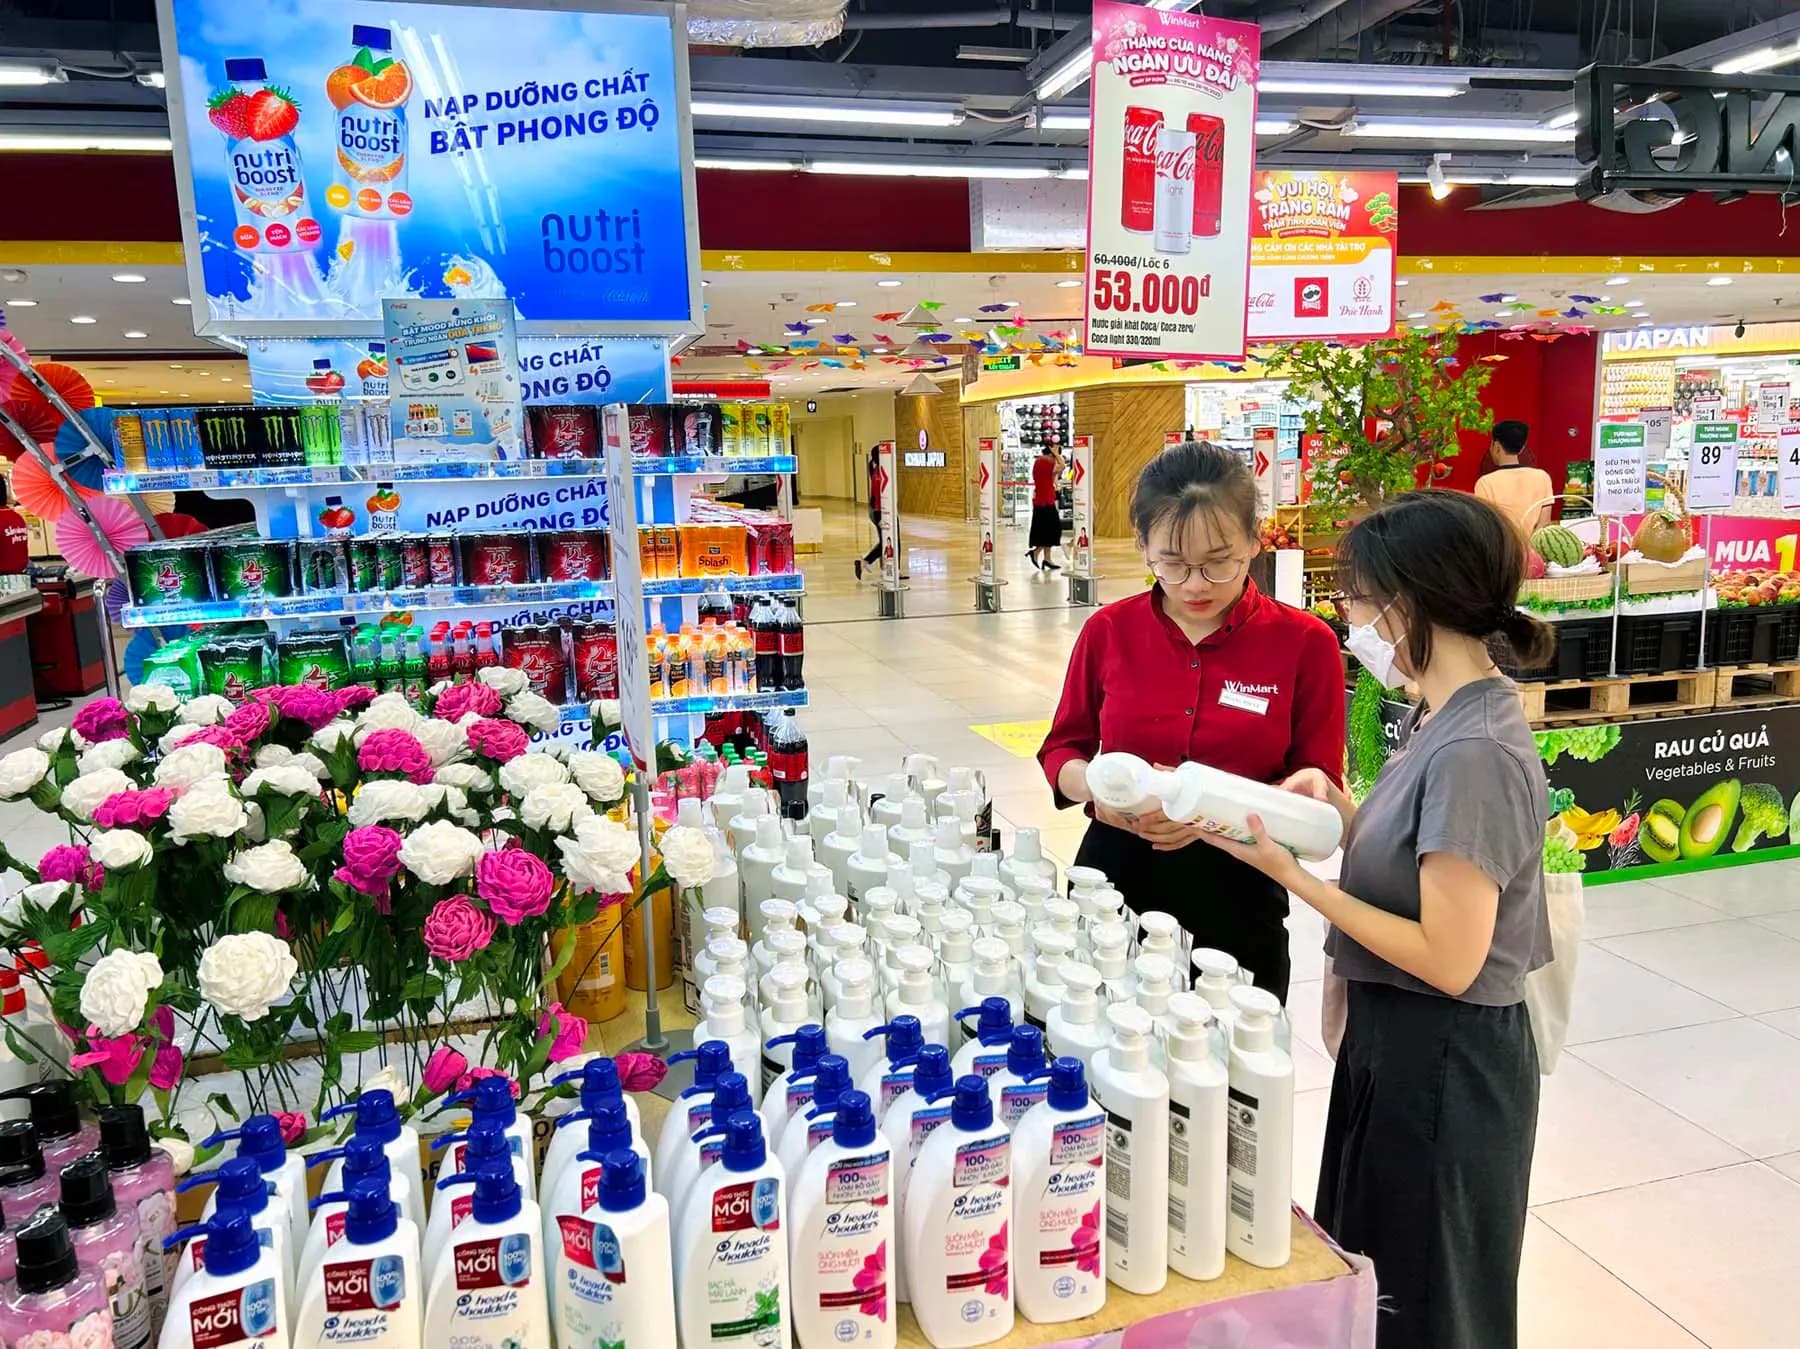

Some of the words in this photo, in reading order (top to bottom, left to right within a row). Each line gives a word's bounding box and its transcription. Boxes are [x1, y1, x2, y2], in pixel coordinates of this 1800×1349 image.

[1158, 12, 1200, 29] WinMart
[1122, 34, 1166, 50] THÁNG
[1198, 44, 1232, 66] NÀNG
[1112, 50, 1170, 75] NGÀN
[1205, 66, 1238, 92] ĐÃI
[424, 94, 478, 120] NẠP
[486, 80, 578, 112] DƯỠNG
[584, 68, 650, 98] CHẤT
[342, 116, 398, 136] nutri
[431, 121, 488, 156] BẬT
[498, 111, 608, 145] PHONG
[616, 98, 660, 132] ĐỘ
[342, 132, 400, 153] boost
[234, 148, 292, 169] nutri
[236, 166, 297, 186] boost
[1277, 180, 1303, 197] VUI
[1308, 178, 1334, 200] HỘI
[1259, 198, 1312, 220] TRĂNG
[541, 208, 640, 242] nutri
[543, 239, 645, 275] boost
[1163, 258, 1170, 270] 6
[420, 322, 446, 333] MOOD
[1092, 318, 1109, 329] Nước
[1110, 318, 1122, 330] giải
[1124, 319, 1139, 330] khát
[1161, 322, 1176, 332] Coca
[1092, 333, 1108, 344] Coca
[1110, 334, 1124, 344] light
[1620, 327, 1708, 350] JAPAN
[550, 341, 604, 368] CHẤT
[576, 366, 611, 392] ĐỘ
[363, 388, 389, 396] boost
[1701, 446, 1720, 464] 89
[427, 508, 470, 530] NẠP
[476, 492, 550, 518] DƯỠNG
[556, 478, 608, 503] CHẤT
[372, 522, 396, 530] boost
[698, 555, 728, 568] Splash
[1714, 540, 1771, 562] MUA
[1776, 534, 1798, 573] 1
[1224, 680, 1278, 694] WinMart
[1654, 738, 1695, 758] RAU
[1699, 729, 1724, 754] CỦ
[1730, 724, 1770, 750] QUẢ
[1645, 761, 1721, 781] Vegetables
[1724, 758, 1734, 772] &
[1738, 754, 1776, 770] Fruits
[1049, 1180, 1096, 1194] shoulders
[714, 1198, 750, 1217] MỚI
[844, 1210, 880, 1223] head&
[955, 1201, 1002, 1216] shoulders
[828, 1220, 880, 1233] shoulders
[564, 1229, 591, 1251] MỚI
[734, 1234, 771, 1251] head&
[457, 1254, 496, 1274] MỚI
[718, 1248, 770, 1263] shoulders
[327, 1275, 368, 1296] MỚI
[569, 1282, 612, 1301] shoulders
[579, 1274, 612, 1292] head&
[476, 1290, 518, 1305] head&
[458, 1302, 518, 1318] shoulders
[193, 1307, 238, 1333] MỚI
[344, 1314, 387, 1328] head&
[326, 1326, 387, 1340] shoulders
